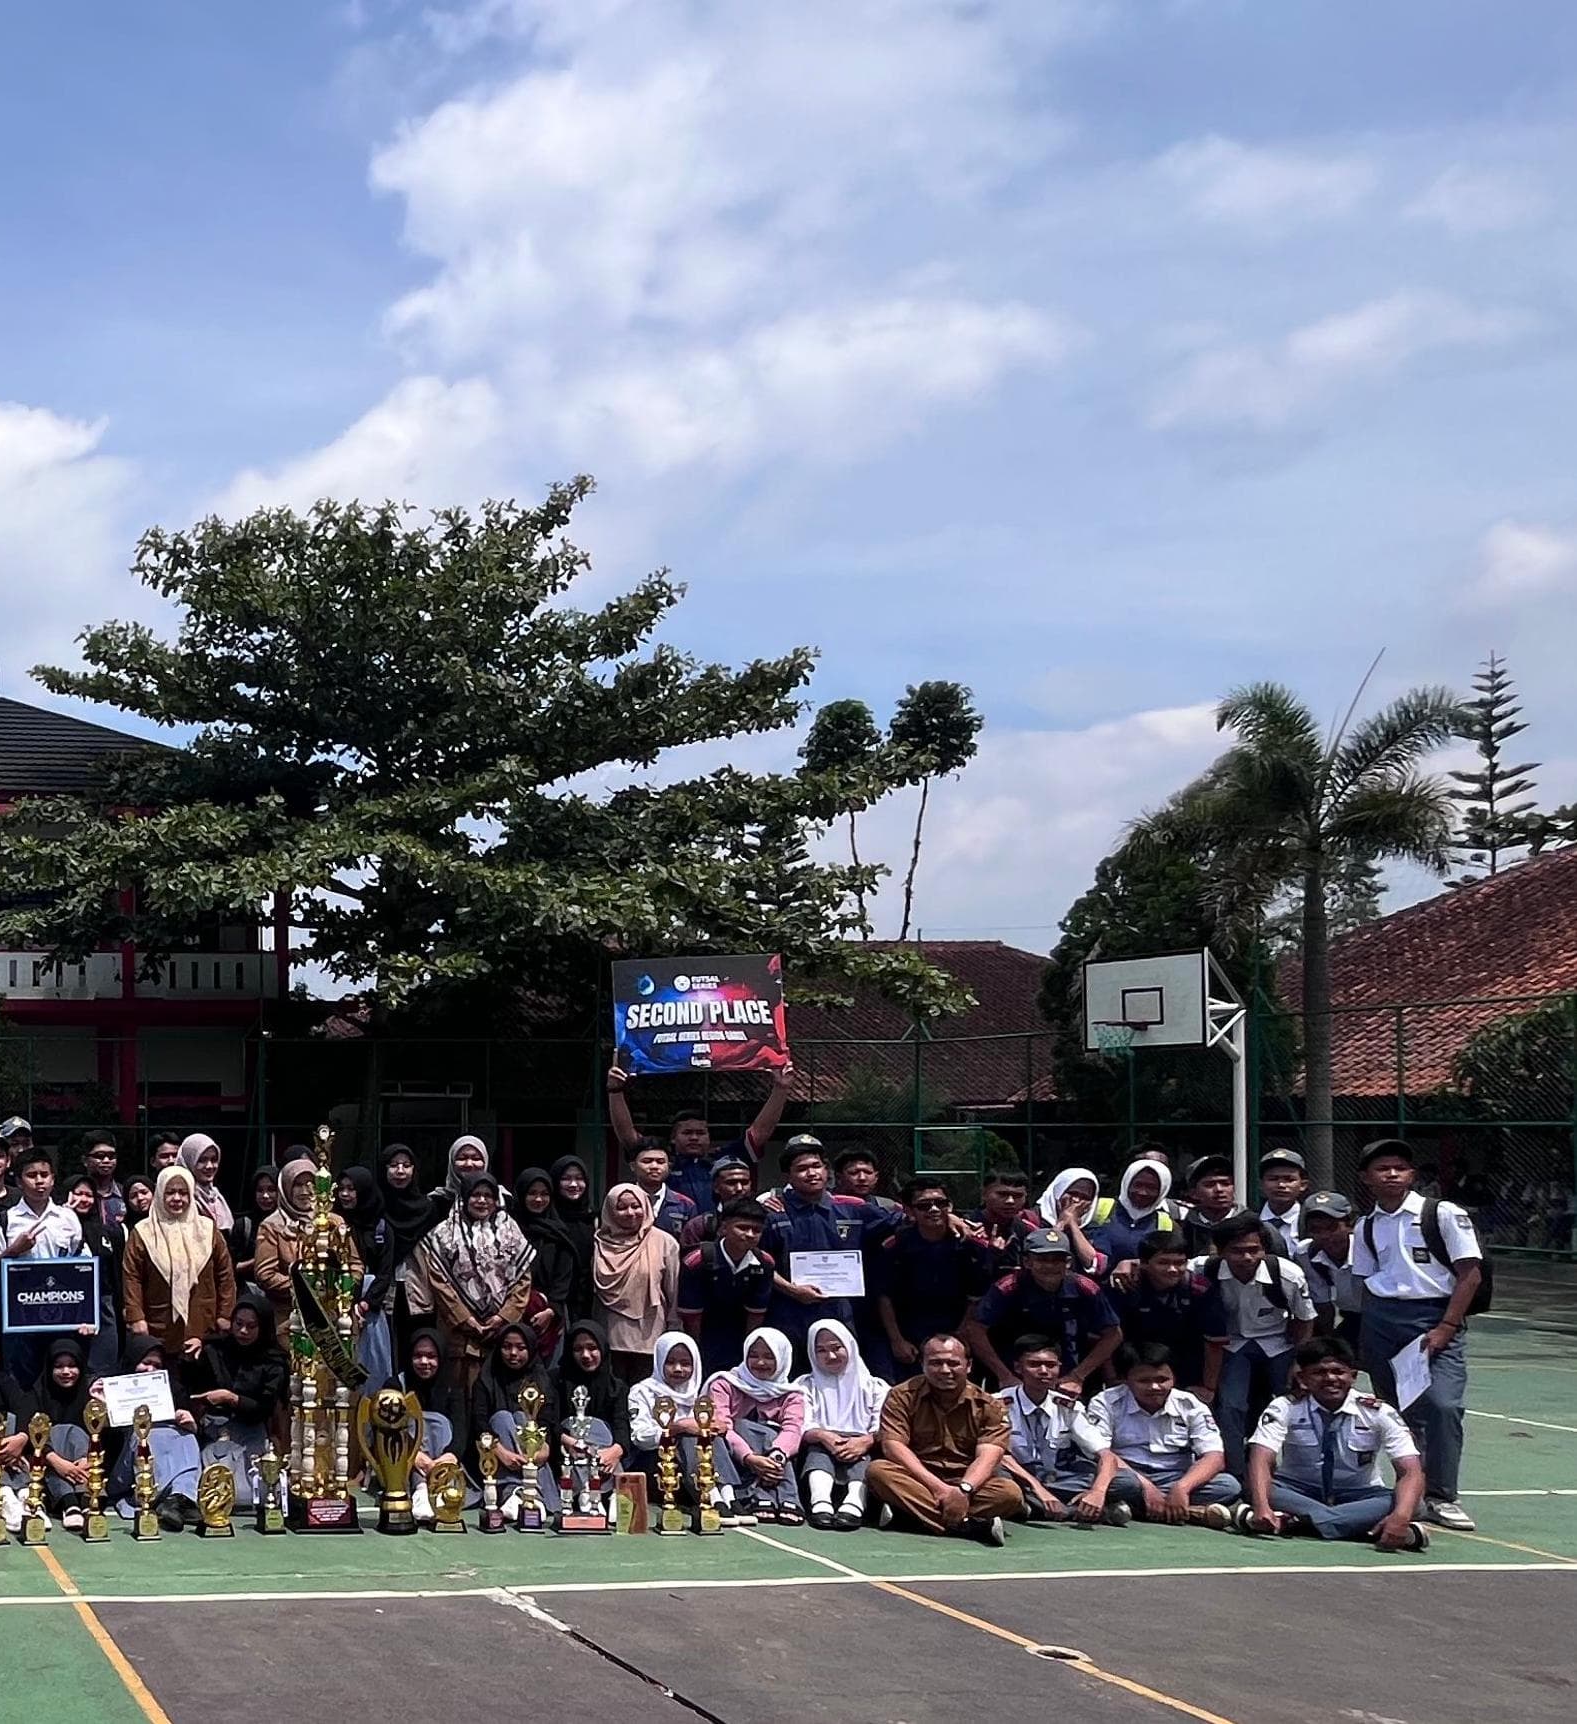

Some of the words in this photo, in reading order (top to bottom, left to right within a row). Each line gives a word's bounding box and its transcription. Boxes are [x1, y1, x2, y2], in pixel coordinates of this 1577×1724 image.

[626, 1002, 703, 1029] SECOND
[710, 1000, 774, 1024] PLACE
[17, 1291, 85, 1302] CHAMPIONS
